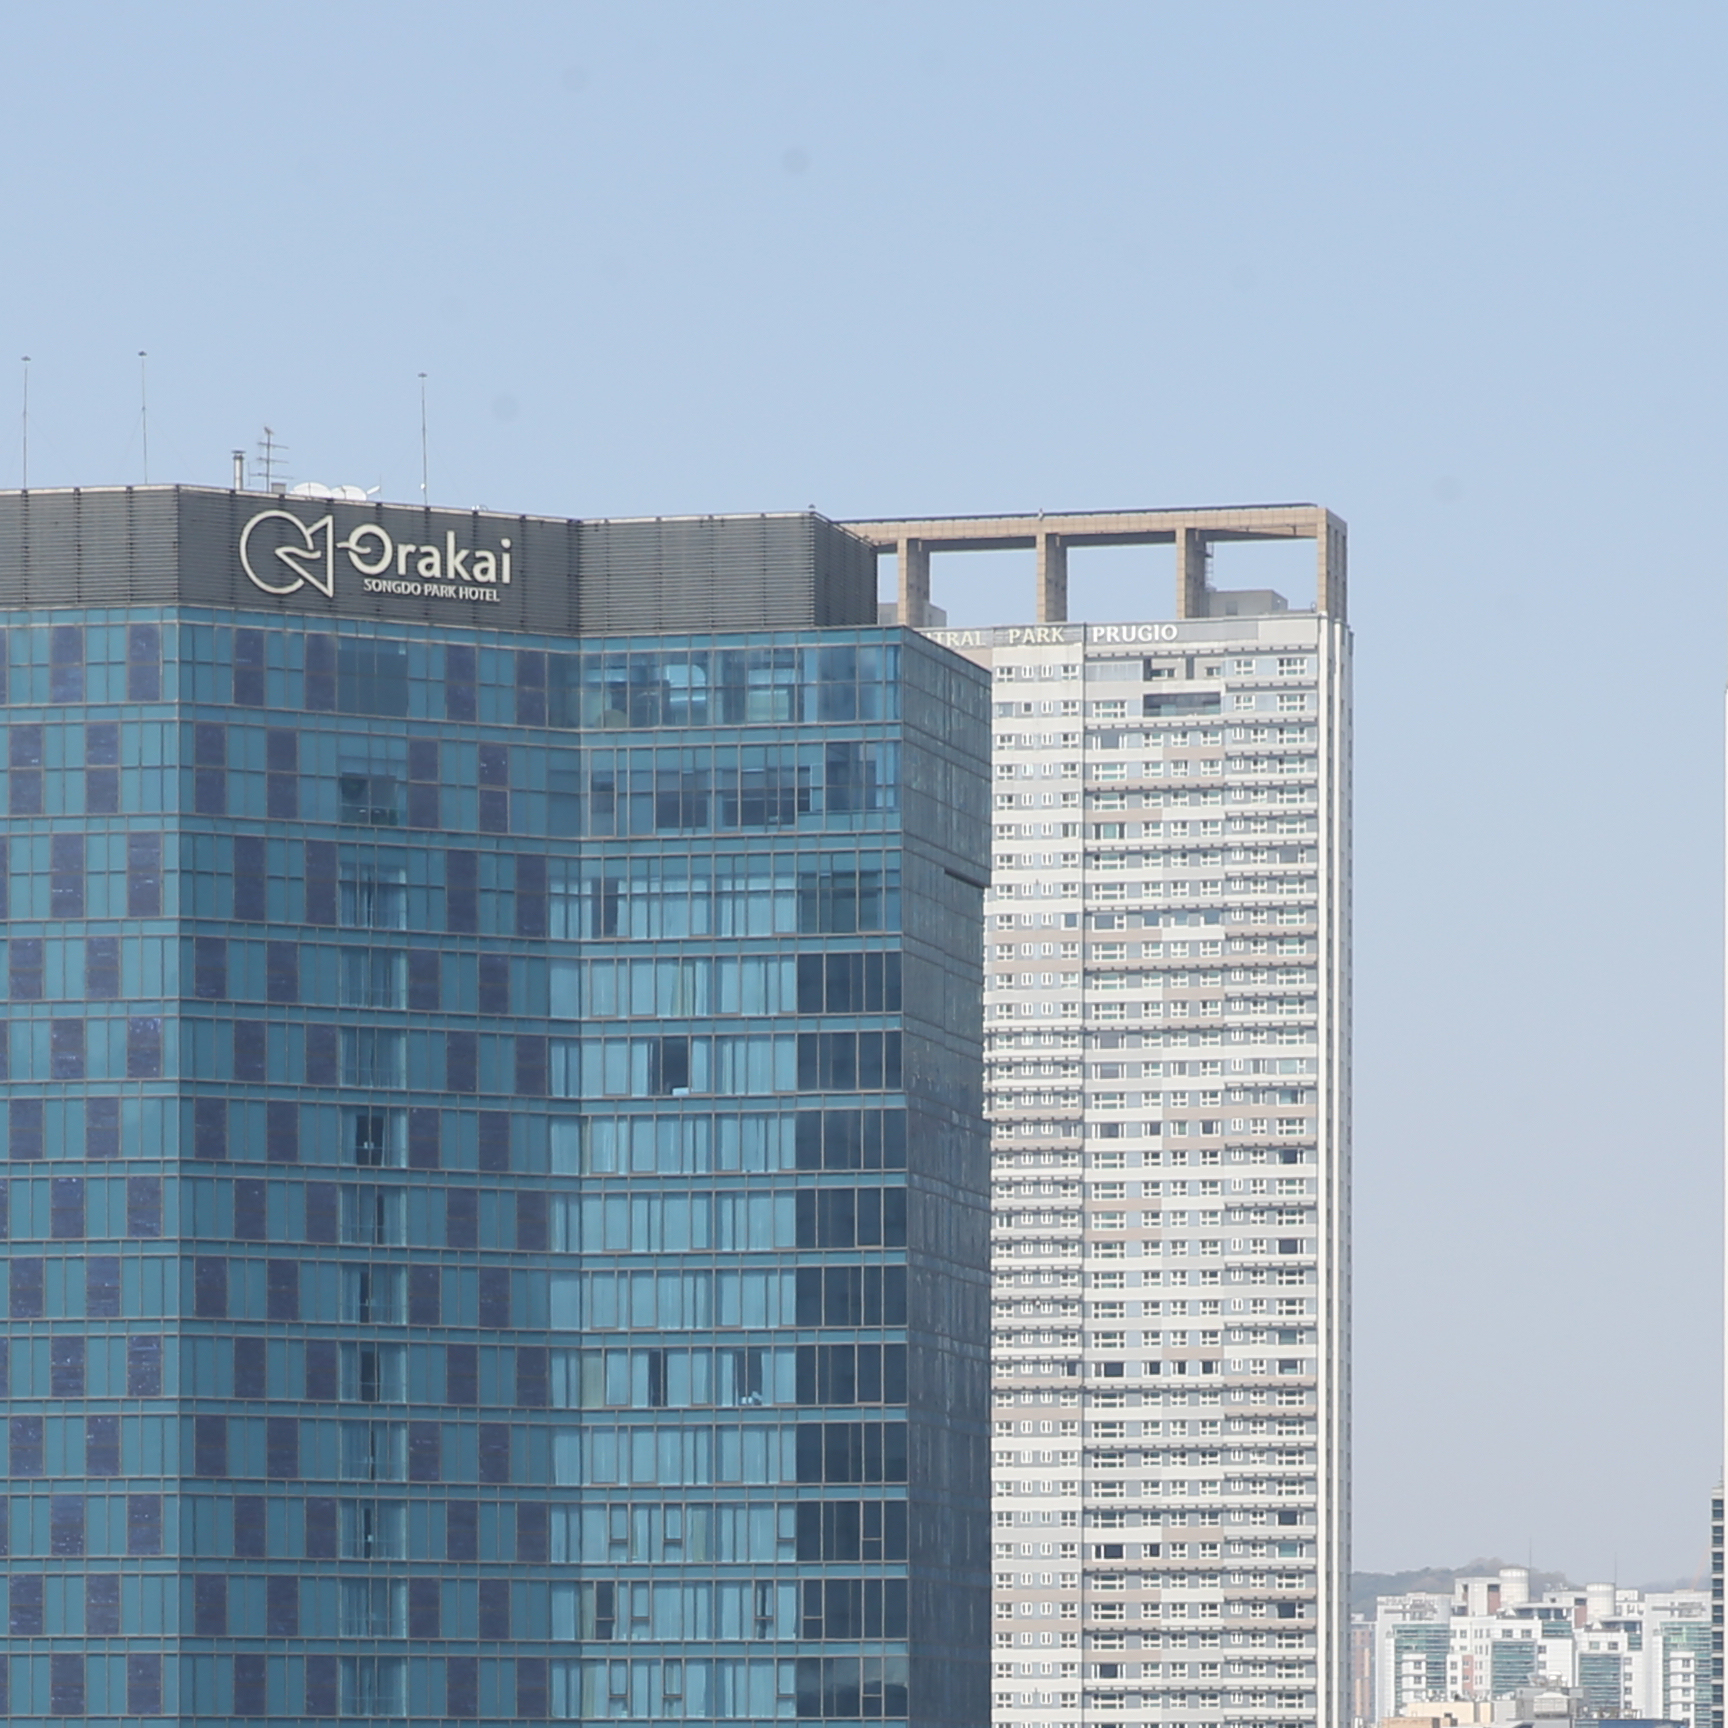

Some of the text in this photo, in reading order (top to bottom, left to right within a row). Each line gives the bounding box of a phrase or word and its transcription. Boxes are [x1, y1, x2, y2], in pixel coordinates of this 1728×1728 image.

[337, 523, 512, 584] Orakai
[363, 578, 501, 602] SONGDO PARK HOTEL
[1008, 626, 1065, 645] PARK
[1091, 623, 1179, 643] PRUGIO
